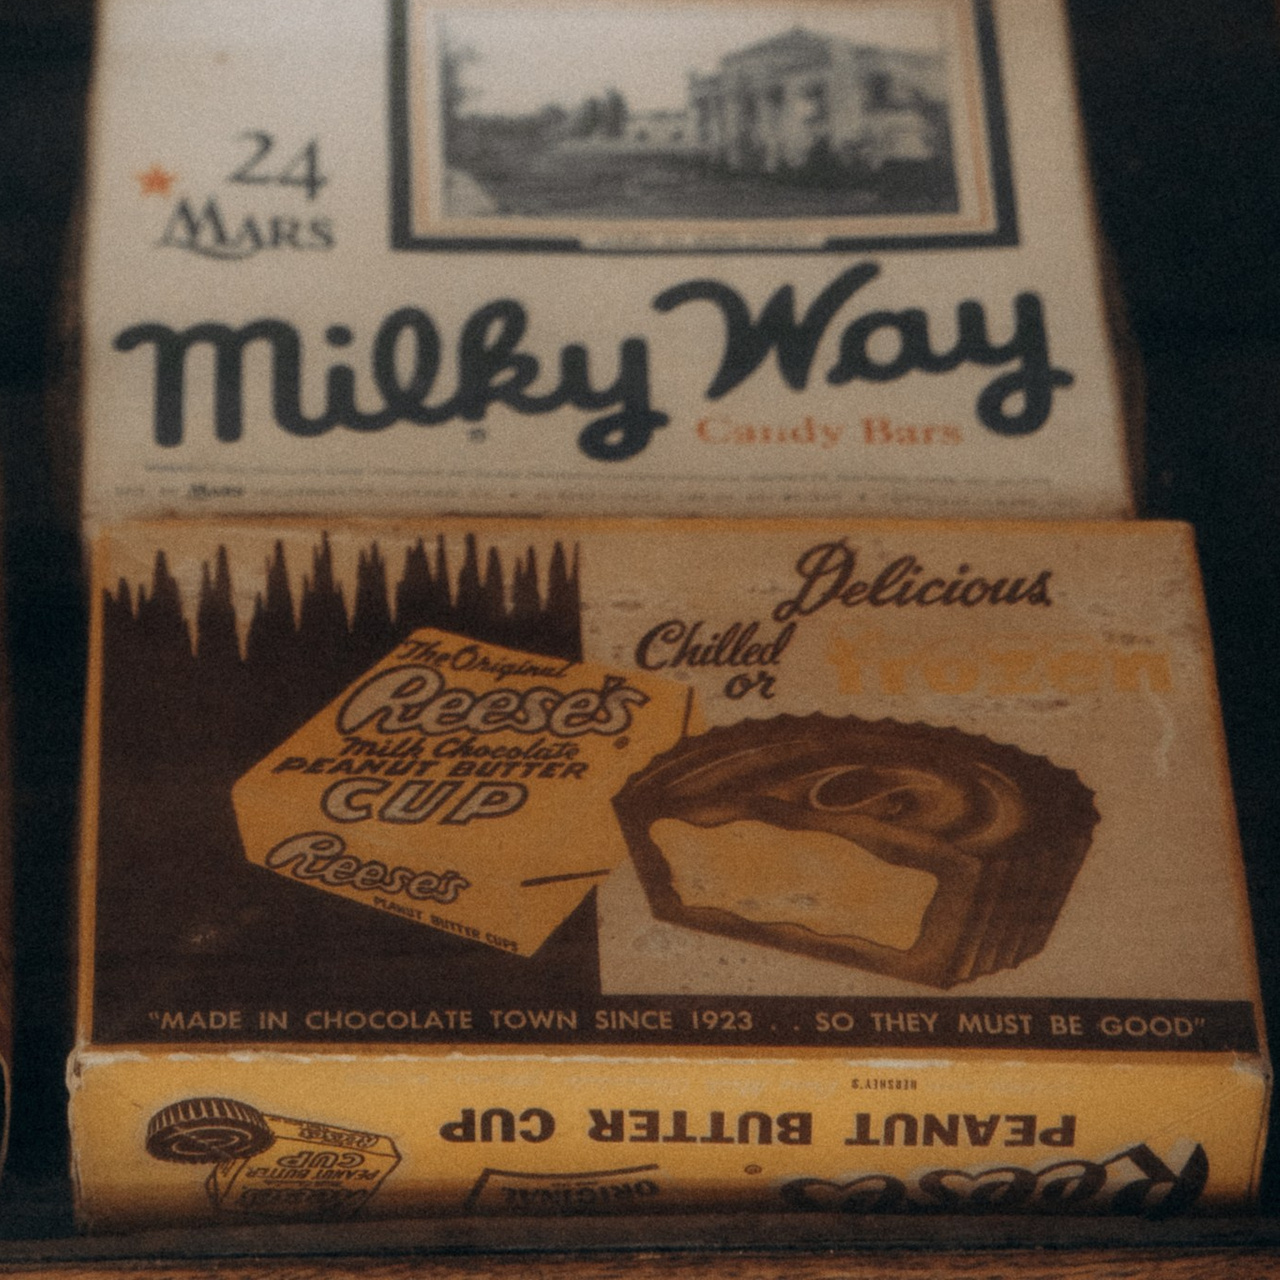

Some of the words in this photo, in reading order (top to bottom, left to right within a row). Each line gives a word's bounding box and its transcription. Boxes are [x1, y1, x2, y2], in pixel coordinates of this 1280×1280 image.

[225, 130, 329, 200] 24
[112, 297, 670, 463] Milky
[649, 260, 1076, 438] Way
[695, 413, 844, 450] Candy
[860, 415, 964, 447] Bars
[772, 536, 1055, 624] Delicious
[634, 619, 798, 673] Chilled
[723, 670, 776, 702] or
[338, 735, 425, 759] Milk
[431, 736, 582, 762] Chocolate
[270, 755, 440, 777] PEANUT
[447, 759, 591, 780] BUTTER
[320, 776, 530, 827] CUP
[258, 1010, 289, 1031] IN
[304, 1010, 474, 1032] CHOCOLATE
[489, 1009, 578, 1032] TOWN
[594, 1009, 674, 1032] SINCE
[690, 1010, 754, 1033] 1923
[815, 1011, 855, 1034] SO
[870, 1011, 939, 1035] THEY
[957, 1012, 1033, 1036] MUST
[1050, 1013, 1084, 1037] BE
[439, 1106, 556, 1144] CUP
[587, 1108, 813, 1146] BUTTER
[844, 1111, 1078, 1148] PEANUT
[276, 1151, 366, 1169] CUP
